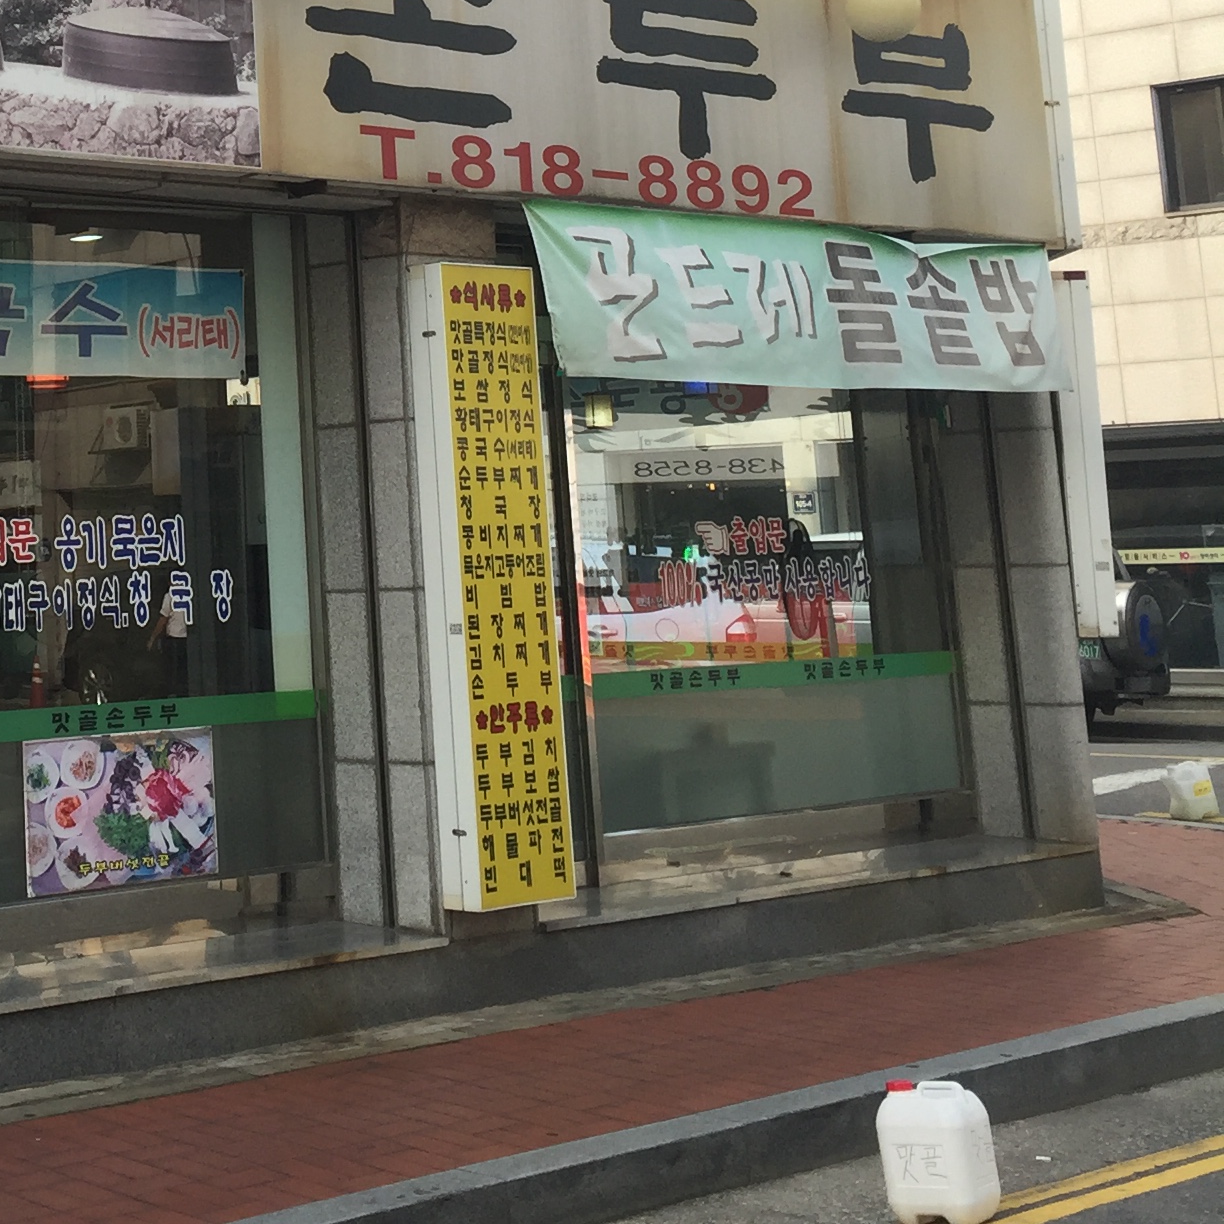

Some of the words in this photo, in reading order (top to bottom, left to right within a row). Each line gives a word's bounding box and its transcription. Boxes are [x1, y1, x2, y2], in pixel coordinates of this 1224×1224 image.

[358, 123, 816, 219] T.818-8892
[449, 319, 507, 347] 맛골특정식
[451, 348, 509, 376] 맛골정식
[53, 513, 108, 573] 옹기
[109, 512, 187, 570] 묵은지
[729, 515, 788, 556] 출입문
[649, 667, 742, 692] 맛골손두부
[51, 703, 180, 734] 맛골손두부
